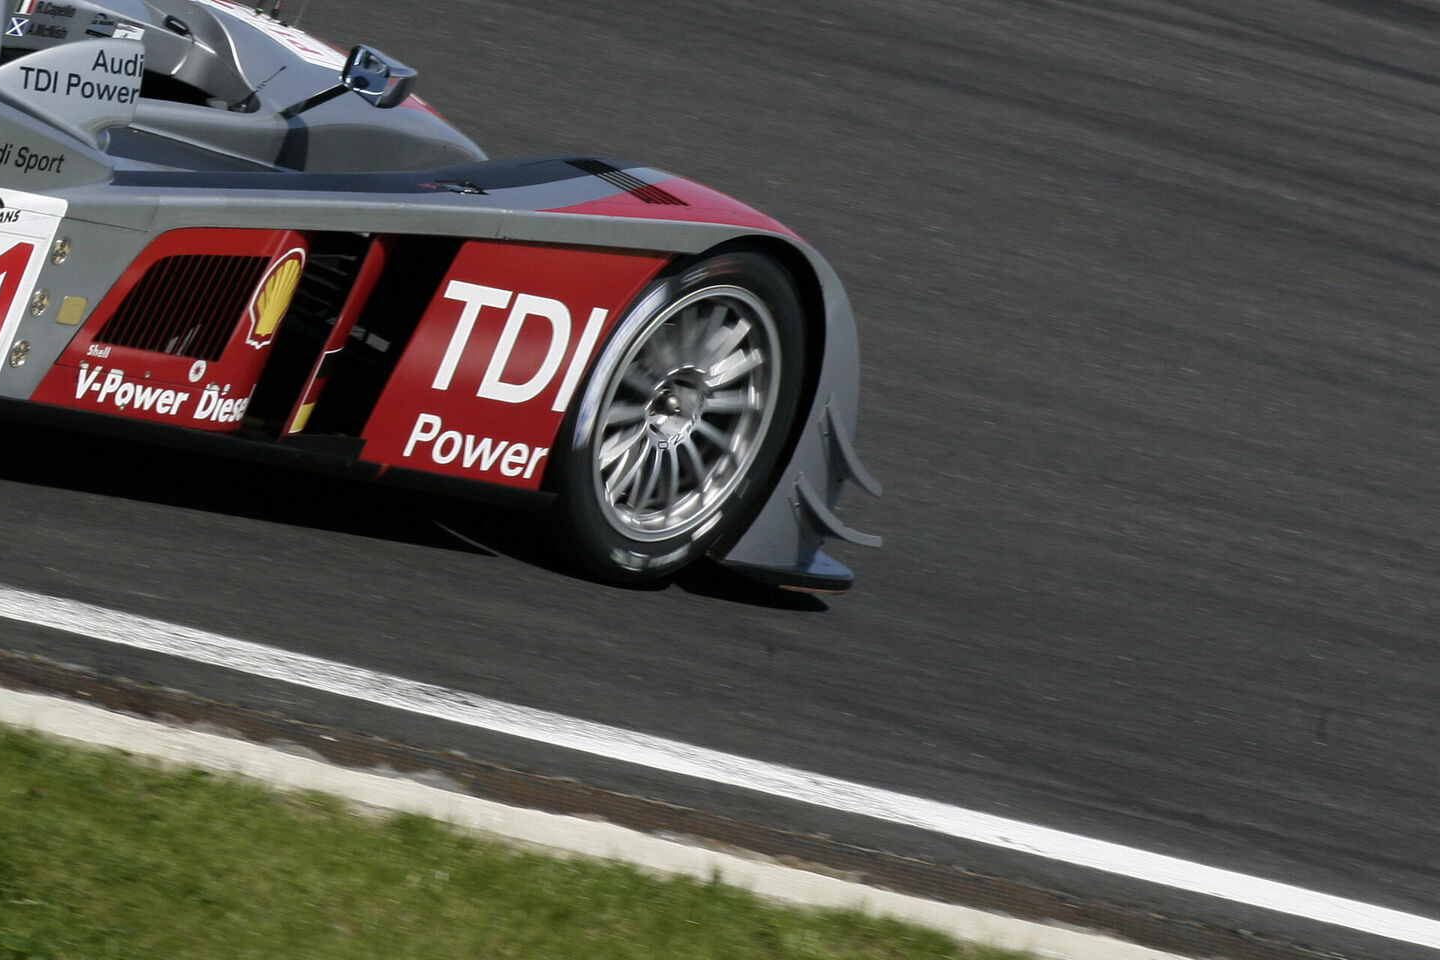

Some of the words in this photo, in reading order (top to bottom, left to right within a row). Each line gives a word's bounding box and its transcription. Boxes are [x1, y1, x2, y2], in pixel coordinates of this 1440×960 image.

[92, 49, 144, 78] Audi
[20, 66, 58, 93] TDI
[65, 73, 139, 104] Power
[14, 146, 65, 173] Sport
[87, 344, 111, 358] Shell
[431, 280, 608, 412] TDI
[75, 362, 190, 417] V-Power
[193, 383, 256, 423] Diese
[403, 413, 549, 480] Power
